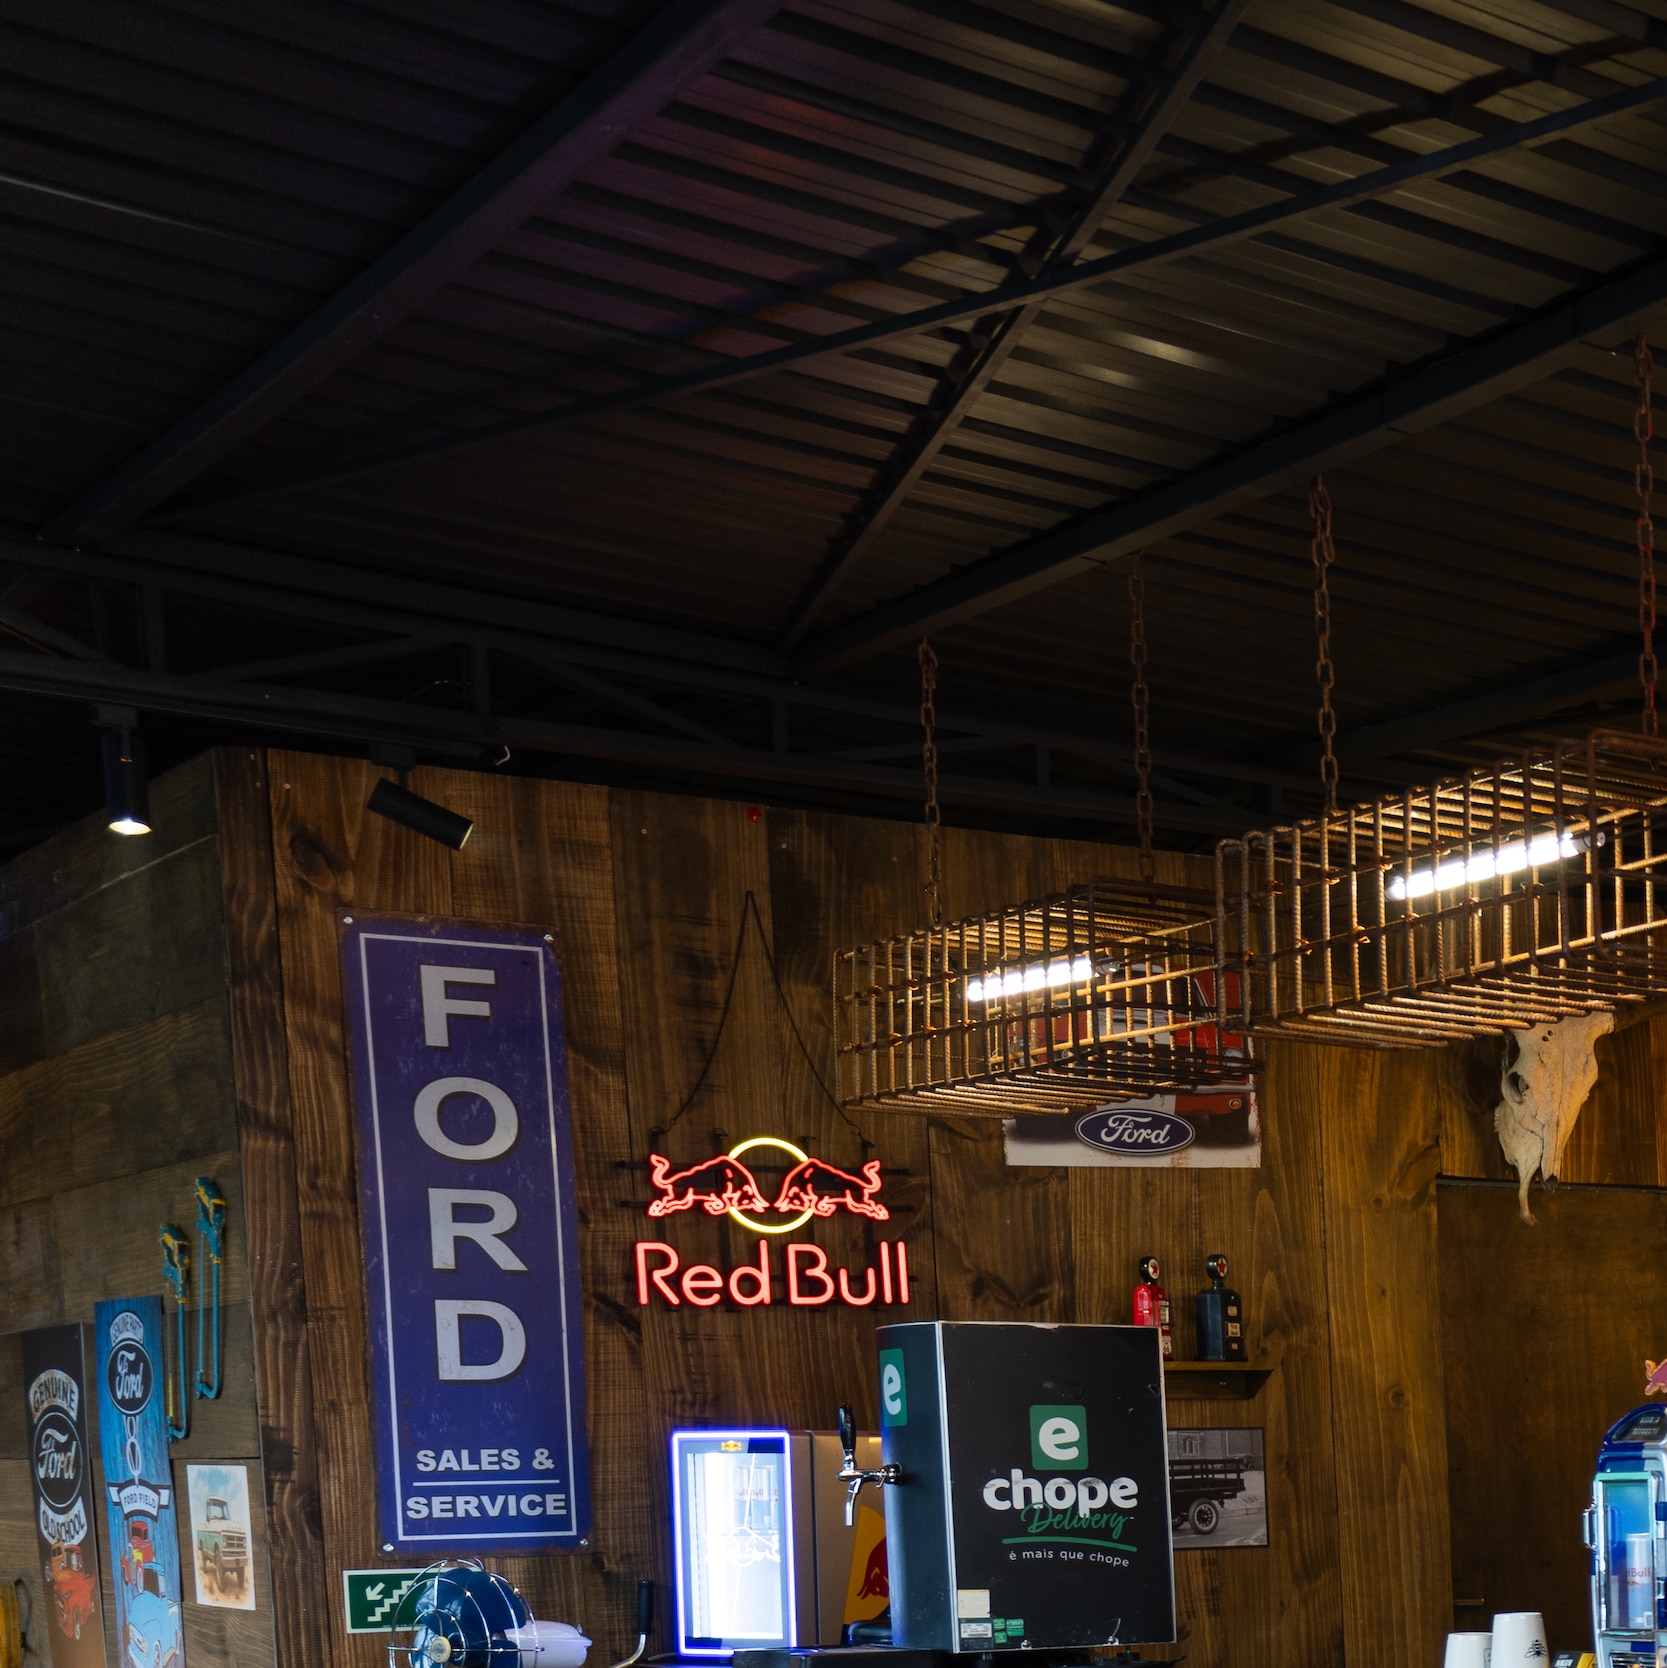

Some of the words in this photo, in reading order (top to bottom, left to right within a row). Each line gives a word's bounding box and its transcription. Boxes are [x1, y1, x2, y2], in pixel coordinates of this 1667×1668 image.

[1100, 1114, 1171, 1144] Ford
[413, 963, 528, 1382] FORD
[635, 1240, 771, 1306] Red
[787, 1240, 910, 1306] Bull
[33, 1376, 76, 1412] GENUINE
[116, 1350, 144, 1400] Ford
[883, 1364, 902, 1415] e
[38, 1428, 77, 1480] Ford
[416, 1447, 521, 1474] SALES
[532, 1447, 556, 1471] &
[1038, 1417, 1080, 1461] e
[406, 1491, 568, 1519] SERVICE
[982, 1468, 1139, 1519] chope
[1020, 1502, 1129, 1540] Delivery
[1022, 1549, 1054, 1559] mais
[1059, 1550, 1084, 1560] que
[1089, 1552, 1130, 1568] chope
